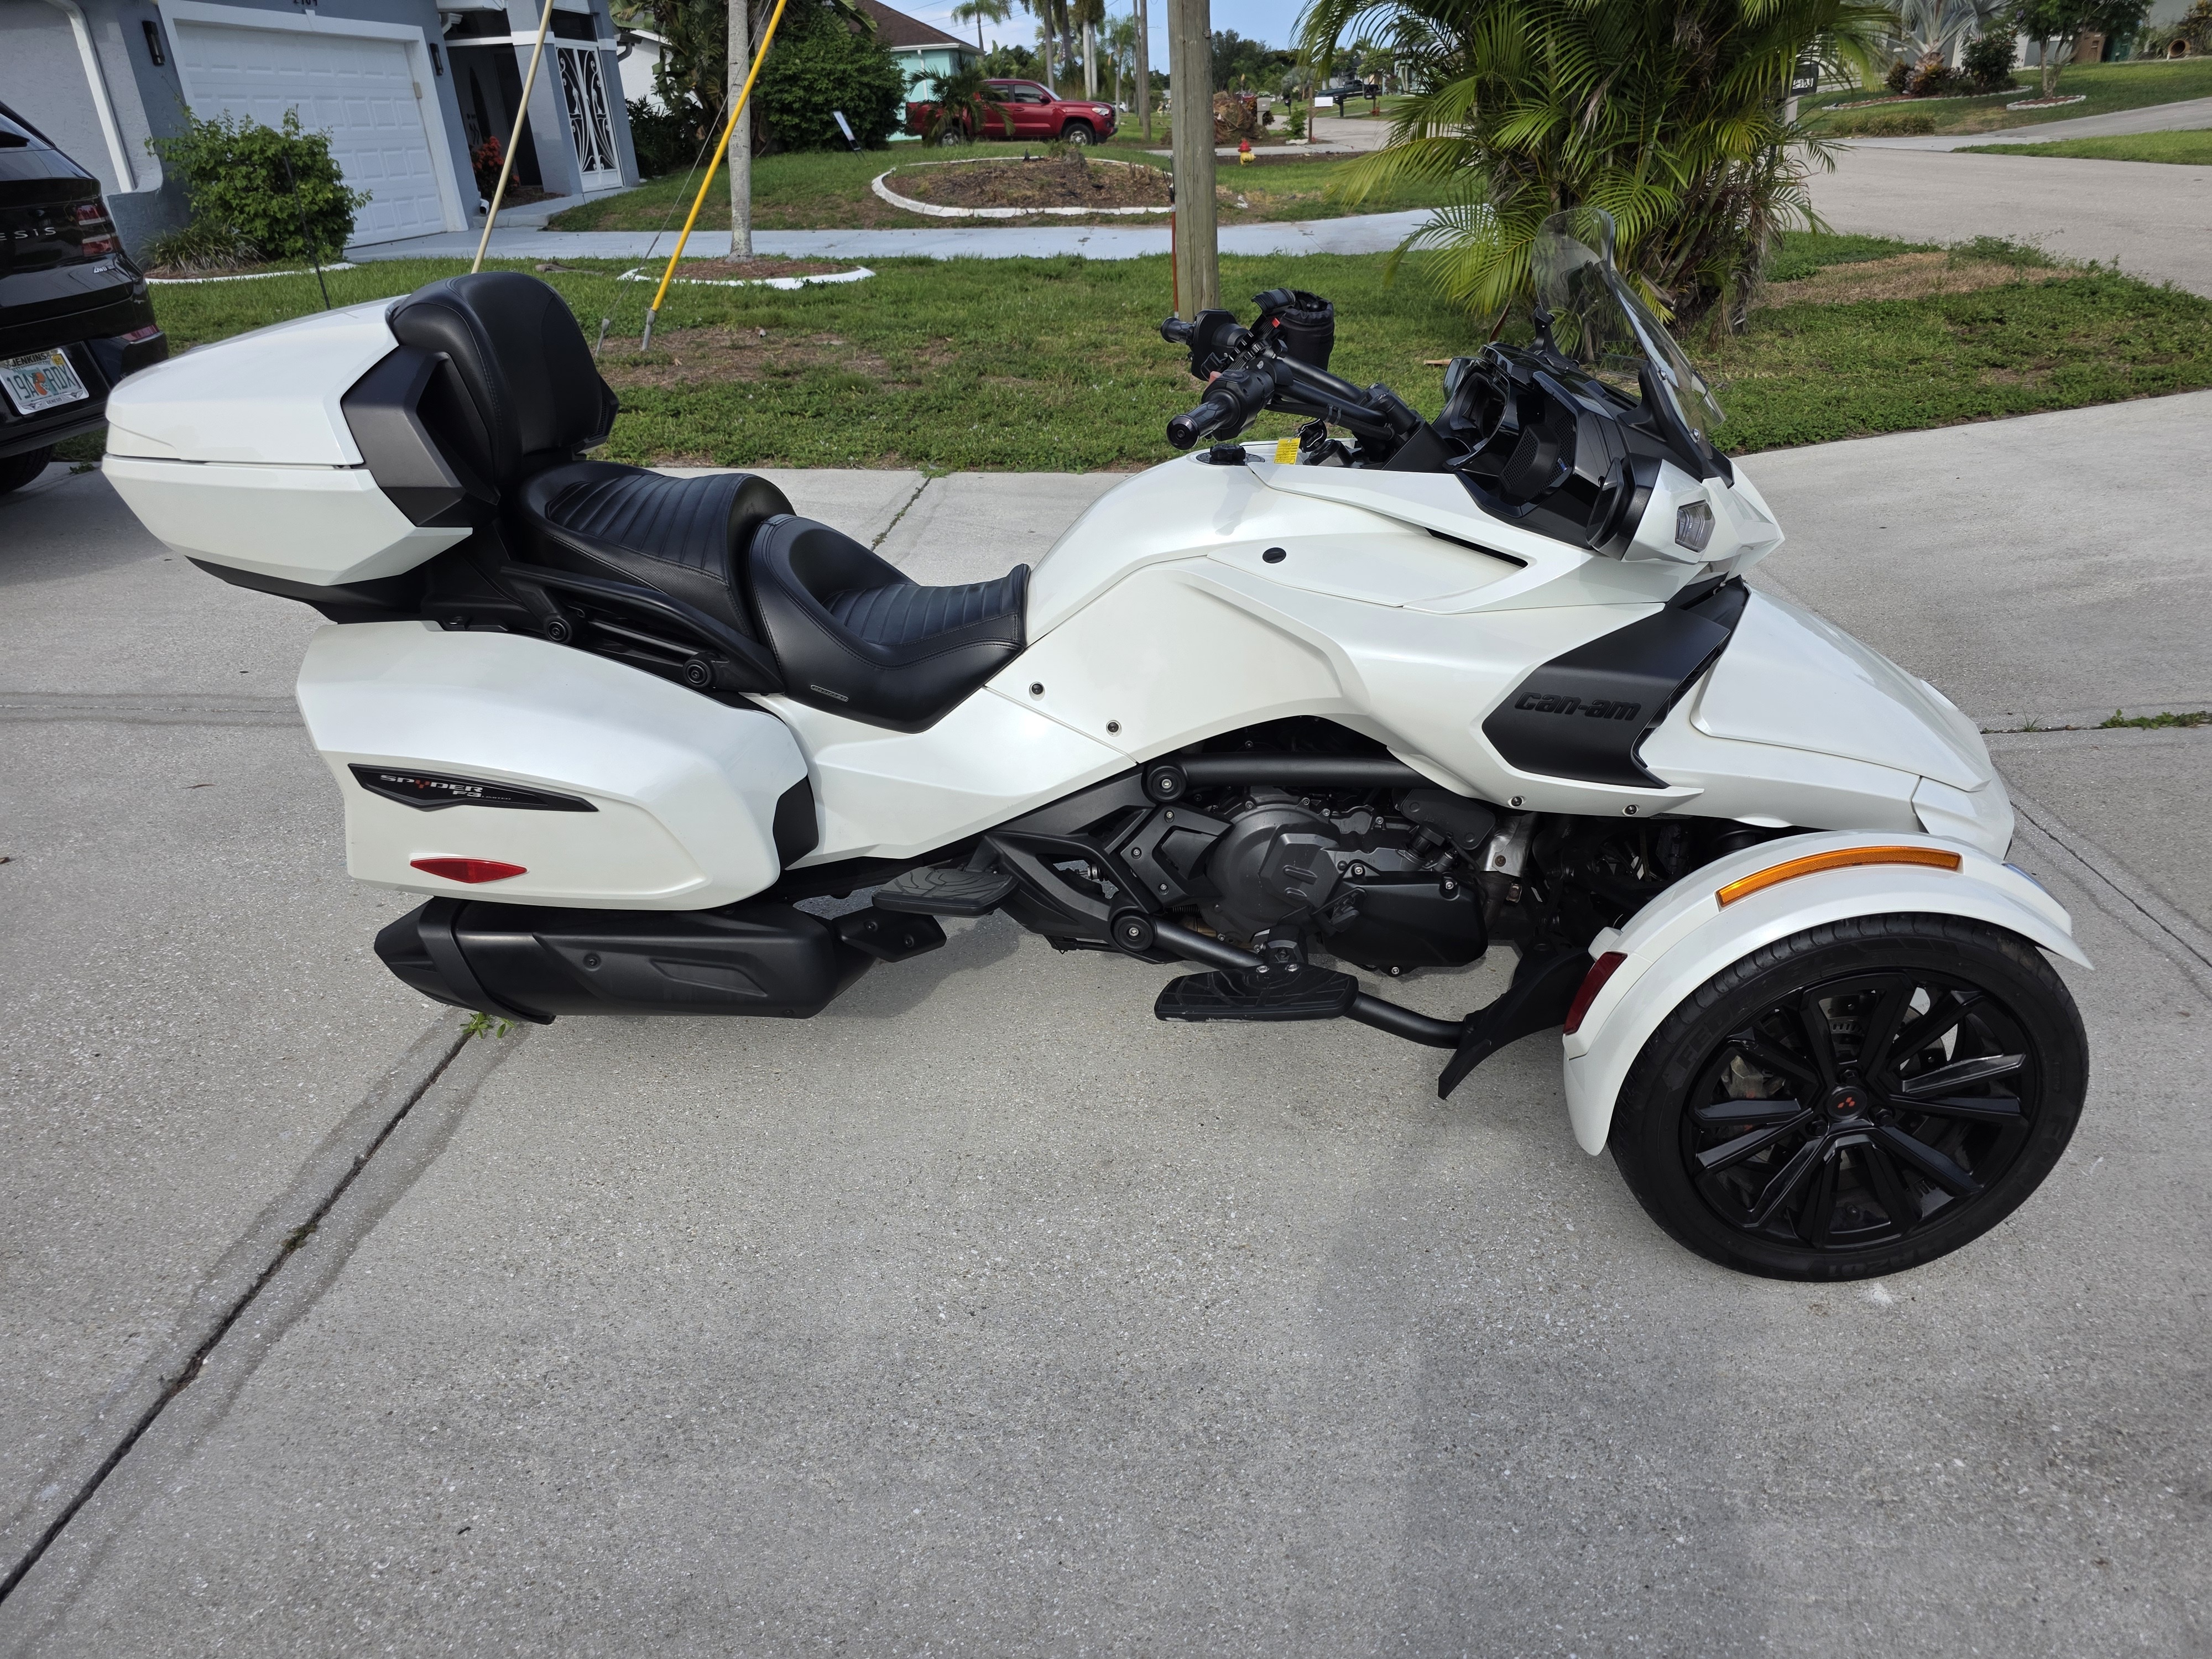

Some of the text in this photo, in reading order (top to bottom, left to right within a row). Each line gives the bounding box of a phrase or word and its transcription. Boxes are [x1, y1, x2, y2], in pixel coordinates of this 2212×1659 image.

[12, 353, 47, 367] JENKINS
[7, 373, 39, 400] 19A
[43, 365, 76, 392] RDX
[1515, 692, 1642, 721] can-am
[380, 775, 483, 792] SPYDER
[452, 790, 482, 798] F3
